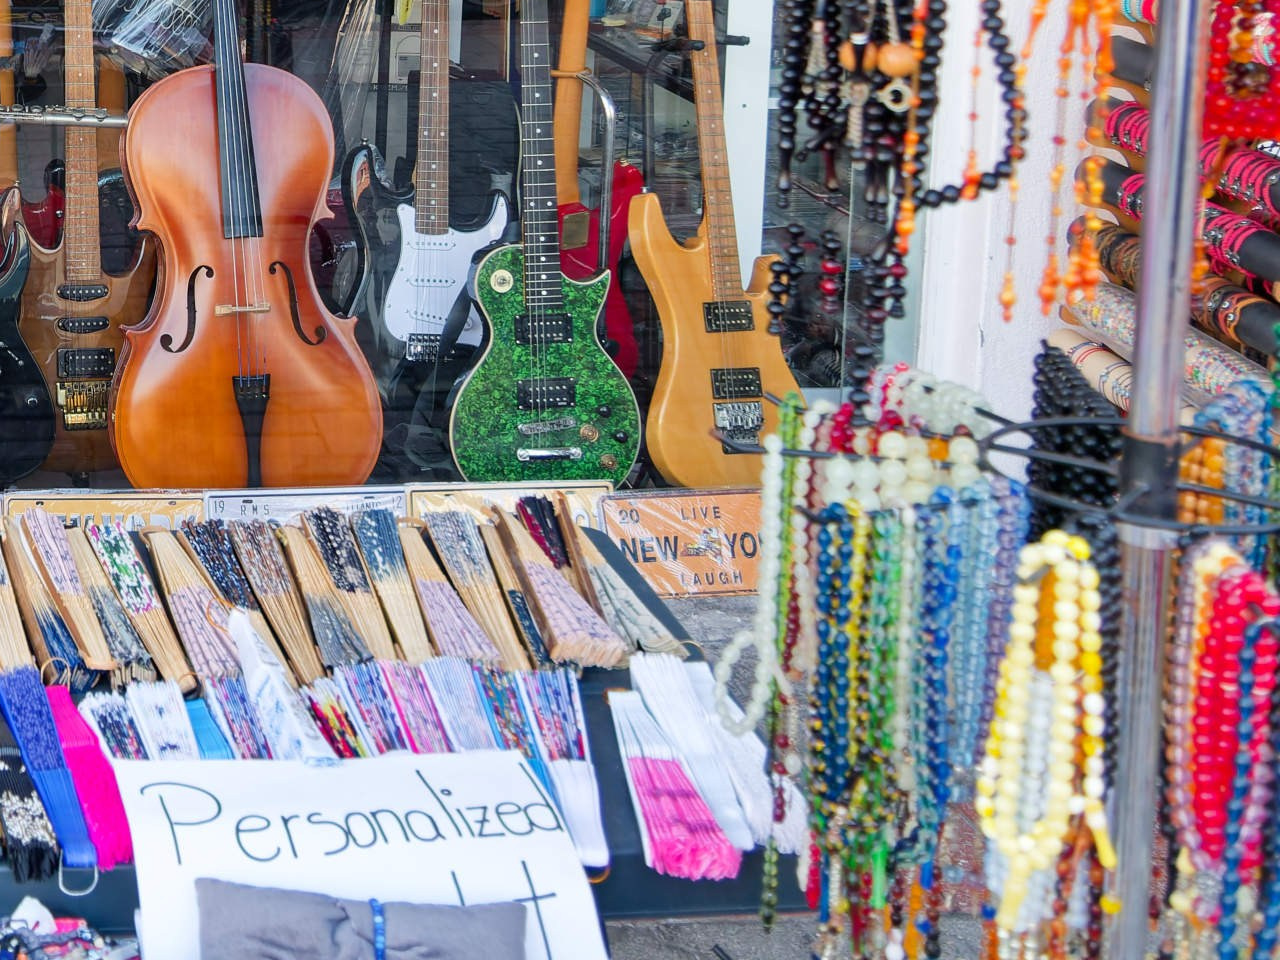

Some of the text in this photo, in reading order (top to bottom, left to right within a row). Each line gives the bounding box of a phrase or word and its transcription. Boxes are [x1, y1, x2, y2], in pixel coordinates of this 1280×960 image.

[214, 500, 225, 514] 19
[619, 506, 721, 524] 20 LIVE
[620, 535, 678, 564] NEW
[681, 571, 743, 586] LAUGH
[140, 761, 566, 866] Personalized
